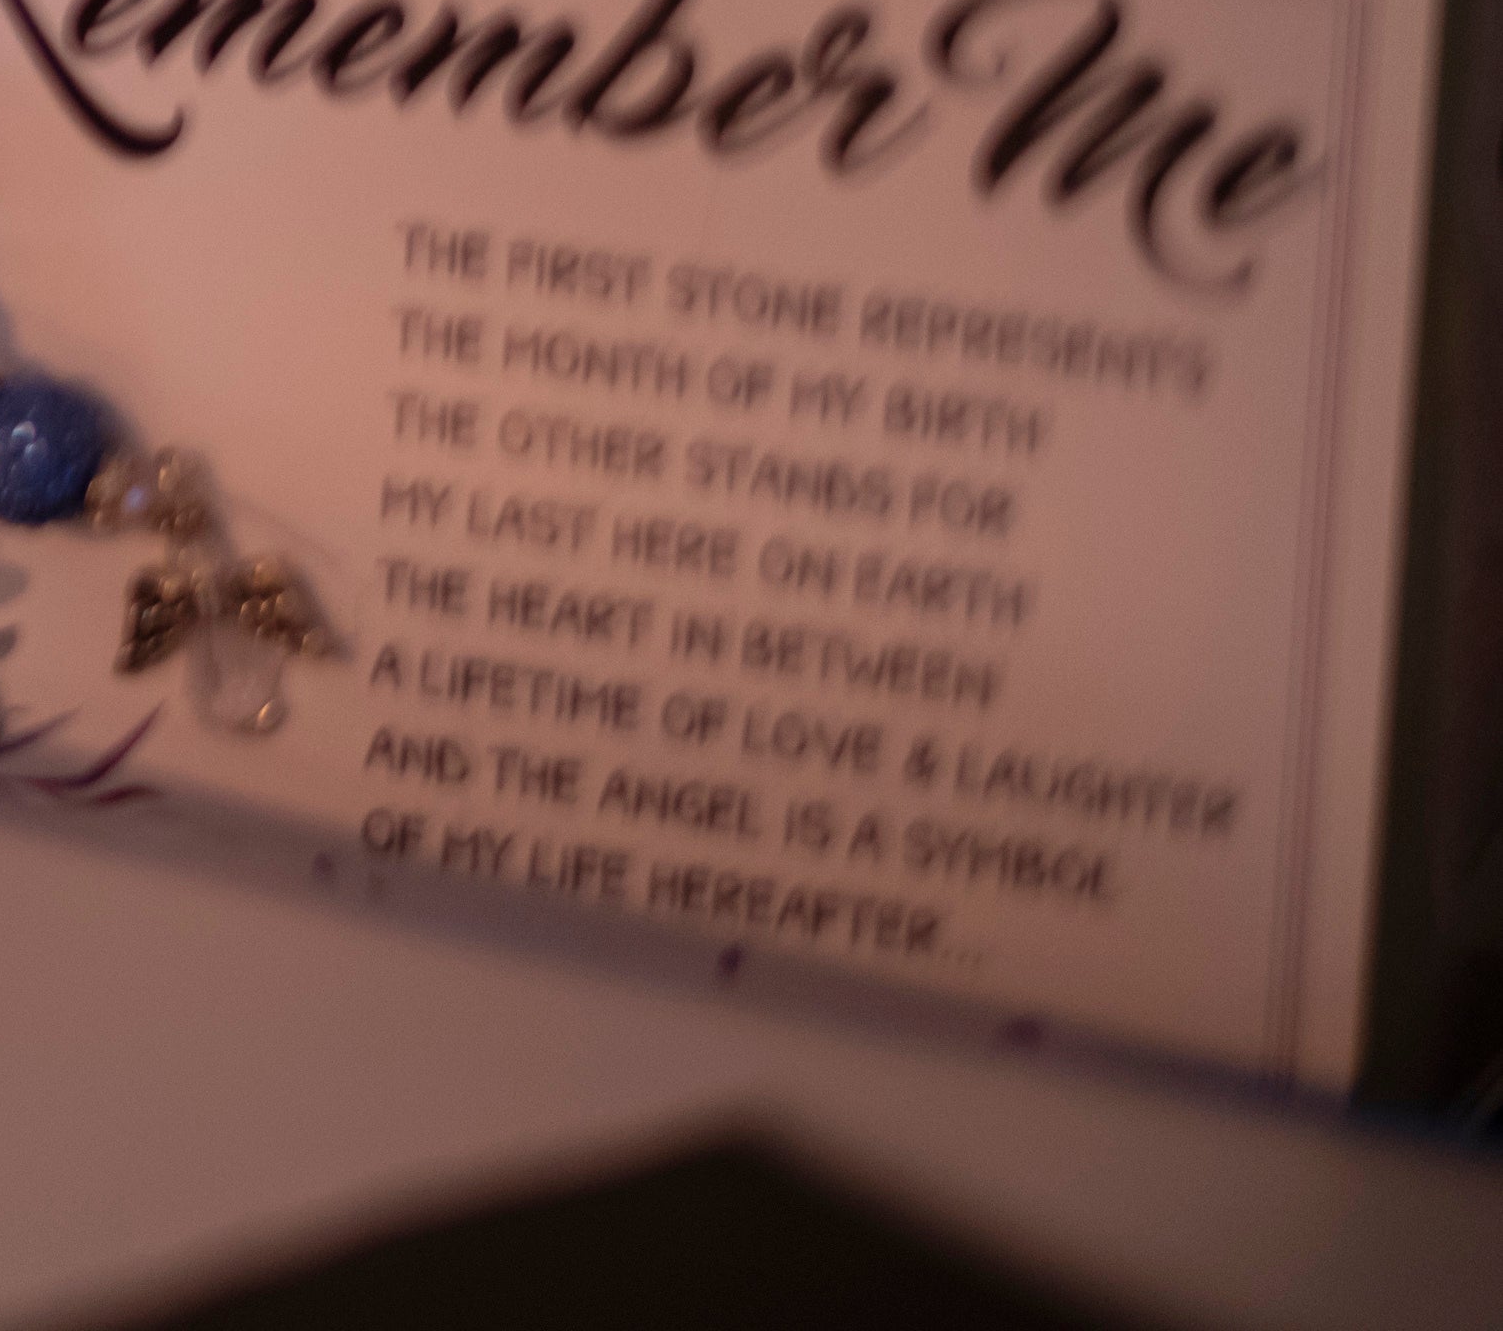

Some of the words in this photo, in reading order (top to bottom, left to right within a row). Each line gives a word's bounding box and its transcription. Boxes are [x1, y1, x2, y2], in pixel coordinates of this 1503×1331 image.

[390, 307, 484, 367] THE
[502, 327, 692, 401] MONTH
[704, 351, 774, 412] OF
[788, 367, 870, 425] MY
[882, 379, 1047, 457] BIRTH
[396, 220, 489, 282] THE
[504, 237, 652, 309] FIRST
[664, 259, 844, 337] STONE
[858, 284, 1212, 405] REPRESENTS
[385, 391, 480, 451] THE
[497, 409, 667, 481] OTHER
[682, 437, 892, 523] STANDS
[907, 477, 1022, 539] FOR
[380, 475, 454, 529] MY
[467, 487, 597, 555] LAST
[612, 511, 740, 581] HERE
[757, 537, 837, 601] ON
[852, 551, 1030, 629] EARTH
[377, 555, 467, 617] THE
[490, 579, 655, 651] HEART
[670, 609, 727, 661] IN
[742, 617, 1004, 713] BETWEEN
[364, 724, 472, 787] AND
[490, 744, 582, 806] THE
[597, 764, 764, 841] ANGEL
[784, 797, 834, 851] IS
[849, 811, 885, 857] A
[902, 819, 1114, 904] SYMBOL
[370, 644, 404, 691] A
[420, 654, 642, 734] LIFETIME
[660, 689, 732, 744] OF
[744, 709, 887, 781] LOVE
[904, 747, 938, 787] &
[954, 749, 1242, 841] LAUGHTER
[360, 803, 427, 857] OF
[442, 819, 514, 875] MY
[527, 841, 629, 899] LIFE
